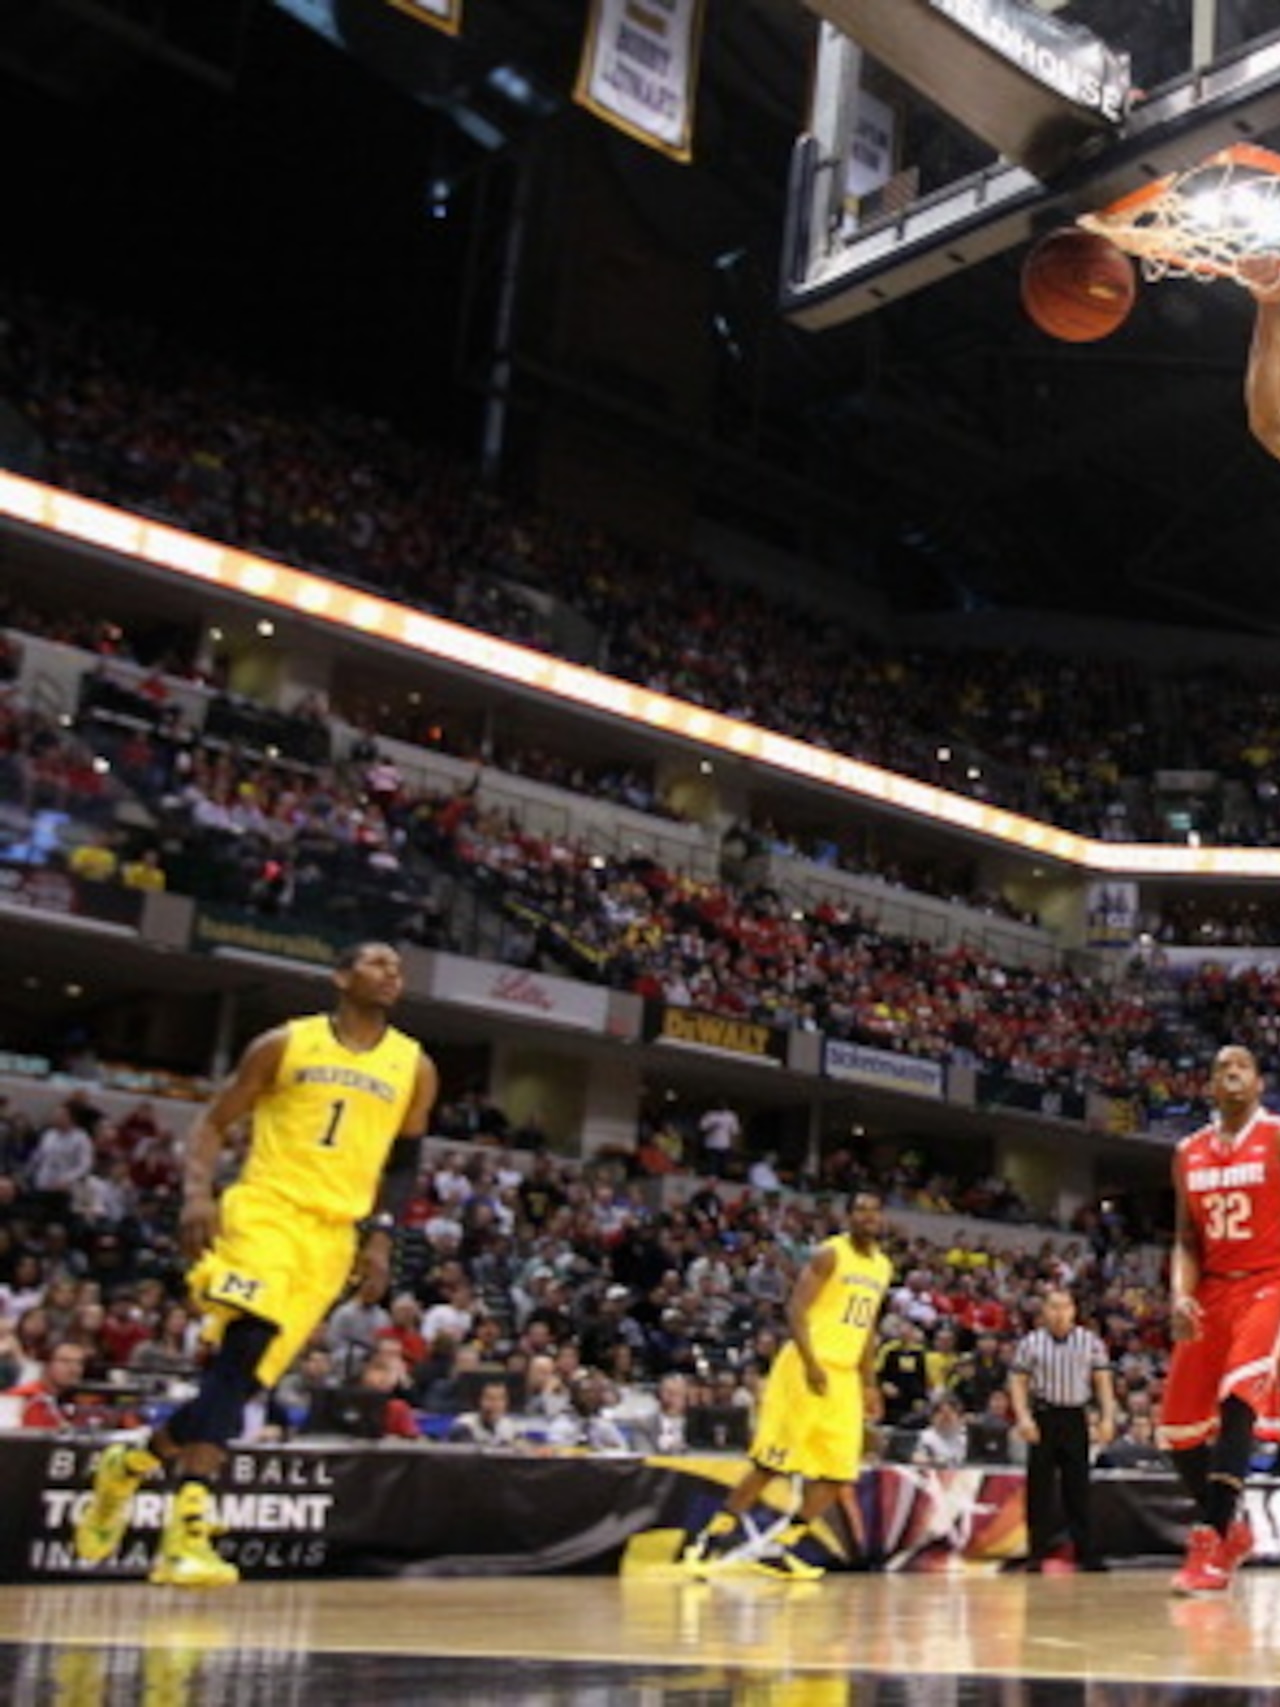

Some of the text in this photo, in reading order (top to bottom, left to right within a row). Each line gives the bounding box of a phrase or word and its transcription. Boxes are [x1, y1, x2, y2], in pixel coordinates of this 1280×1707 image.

[321, 1099, 344, 1148] 1
[1201, 1192, 1253, 1240] 32
[840, 1294, 873, 1328] 10
